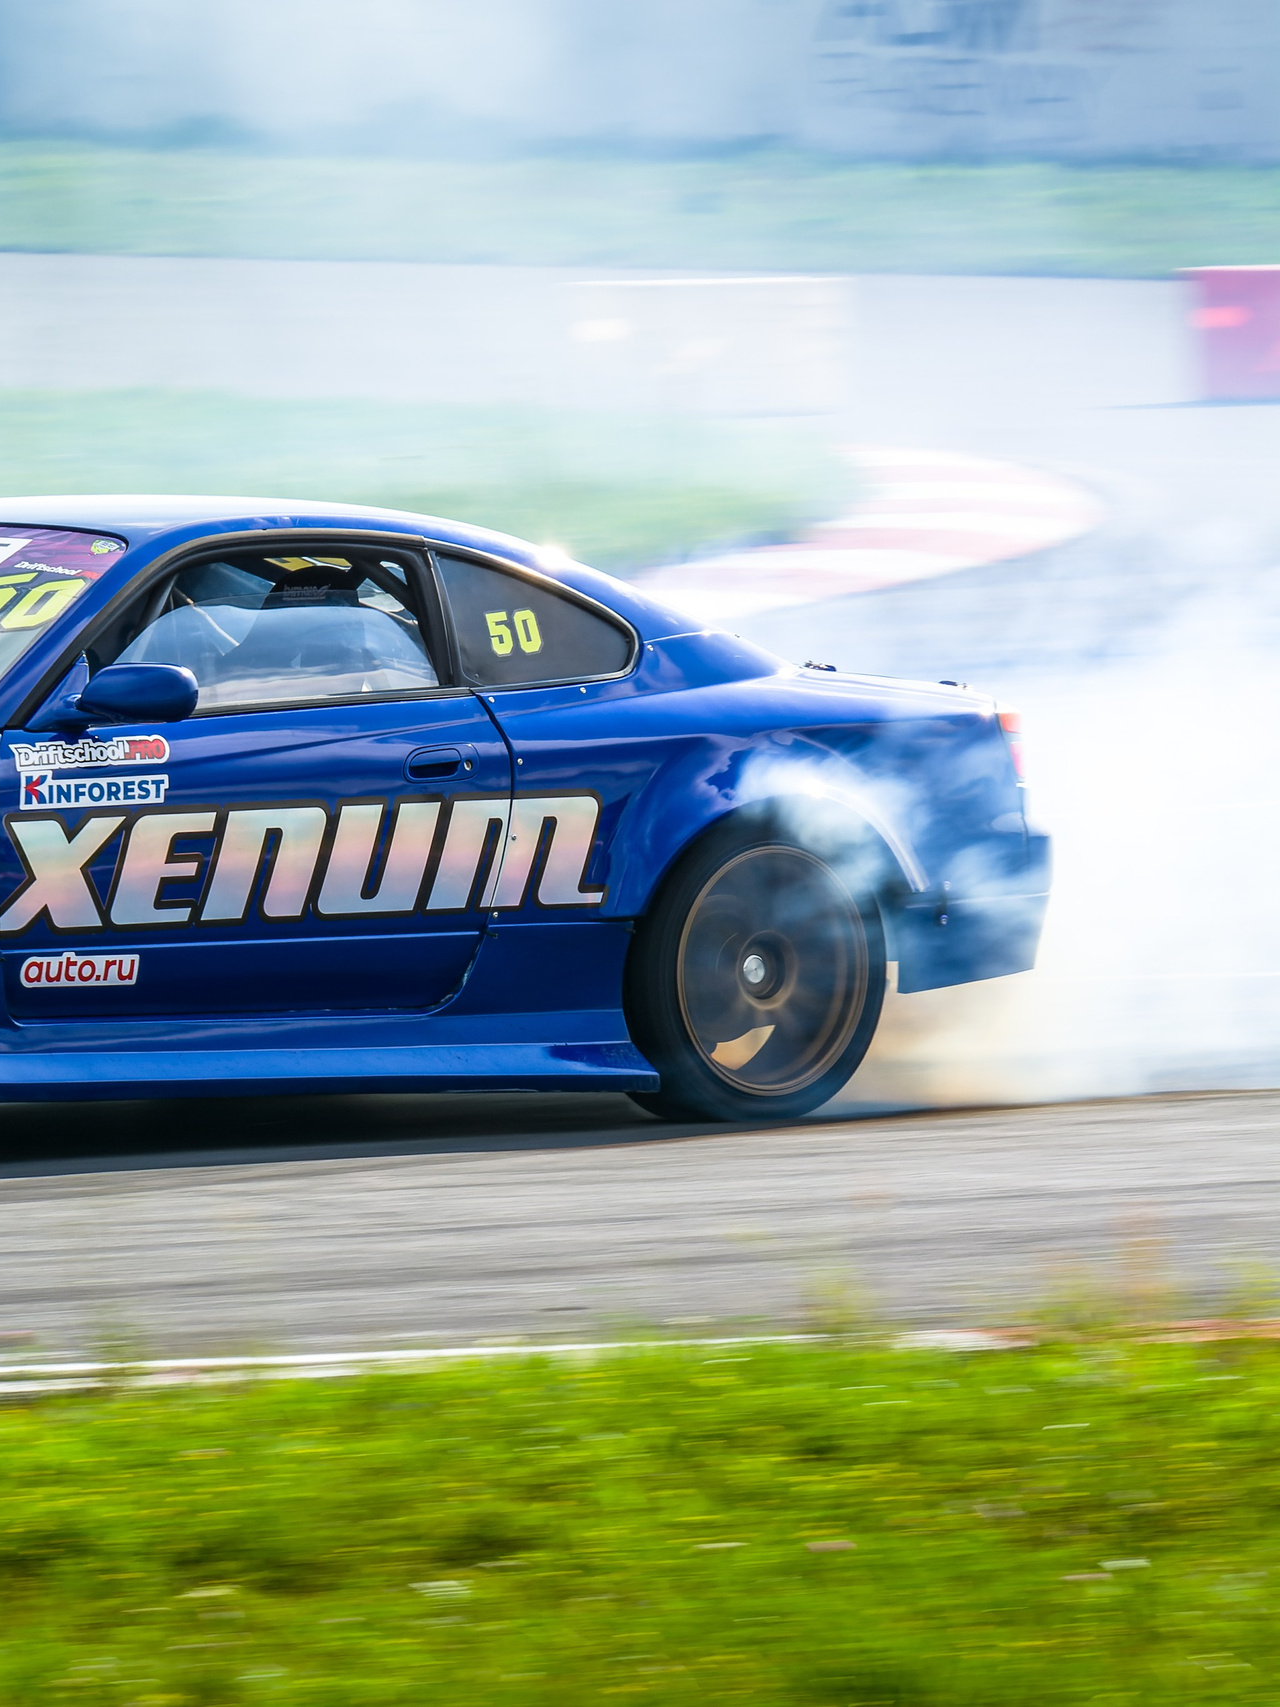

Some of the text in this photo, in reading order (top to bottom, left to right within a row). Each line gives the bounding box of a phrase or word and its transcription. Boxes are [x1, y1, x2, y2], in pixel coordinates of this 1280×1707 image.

[485, 609, 542, 655] 50
[24, 775, 165, 804] KINFOREST
[24, 957, 136, 983] auto.ru
